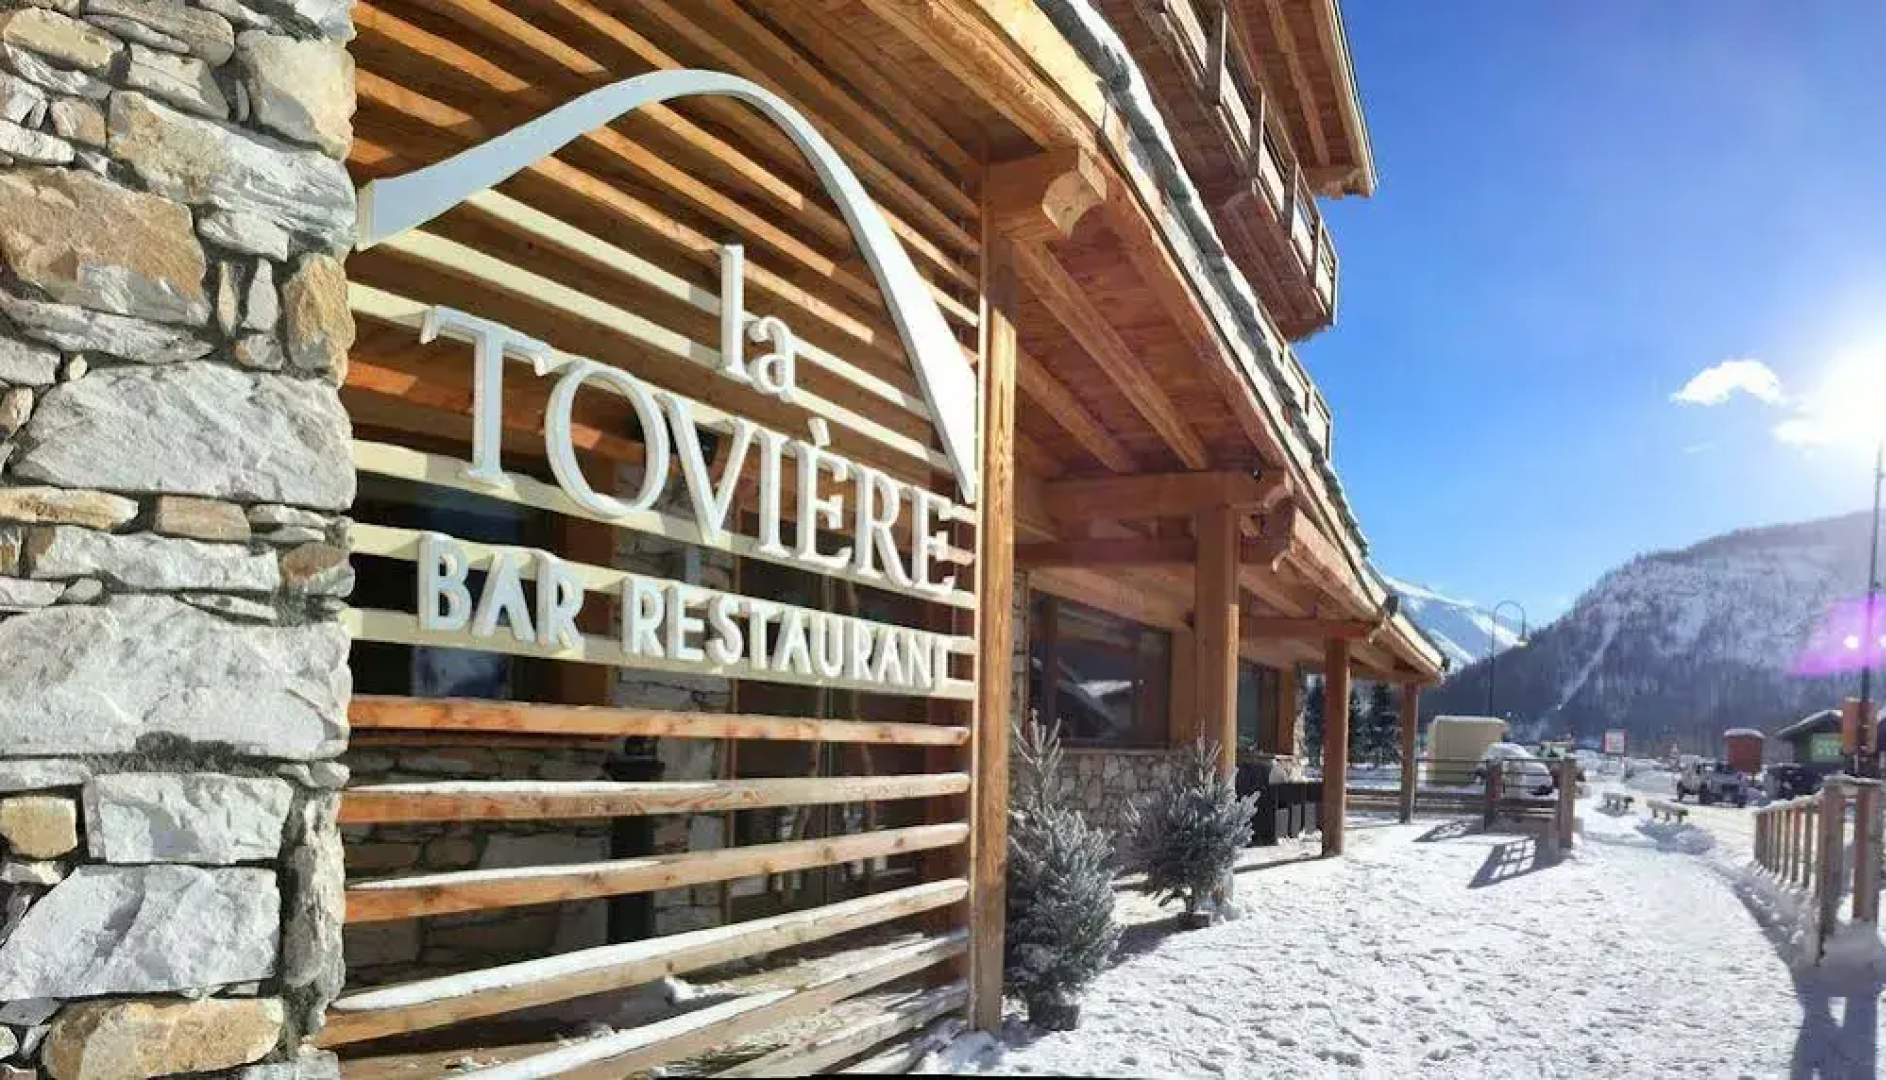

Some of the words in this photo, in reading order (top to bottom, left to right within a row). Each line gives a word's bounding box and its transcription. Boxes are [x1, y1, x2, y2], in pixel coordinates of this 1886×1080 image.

[720, 243, 796, 396] la
[419, 306, 956, 594] TOVIÈRE
[417, 532, 585, 648] BAR
[619, 576, 957, 690] RESTAURANT
